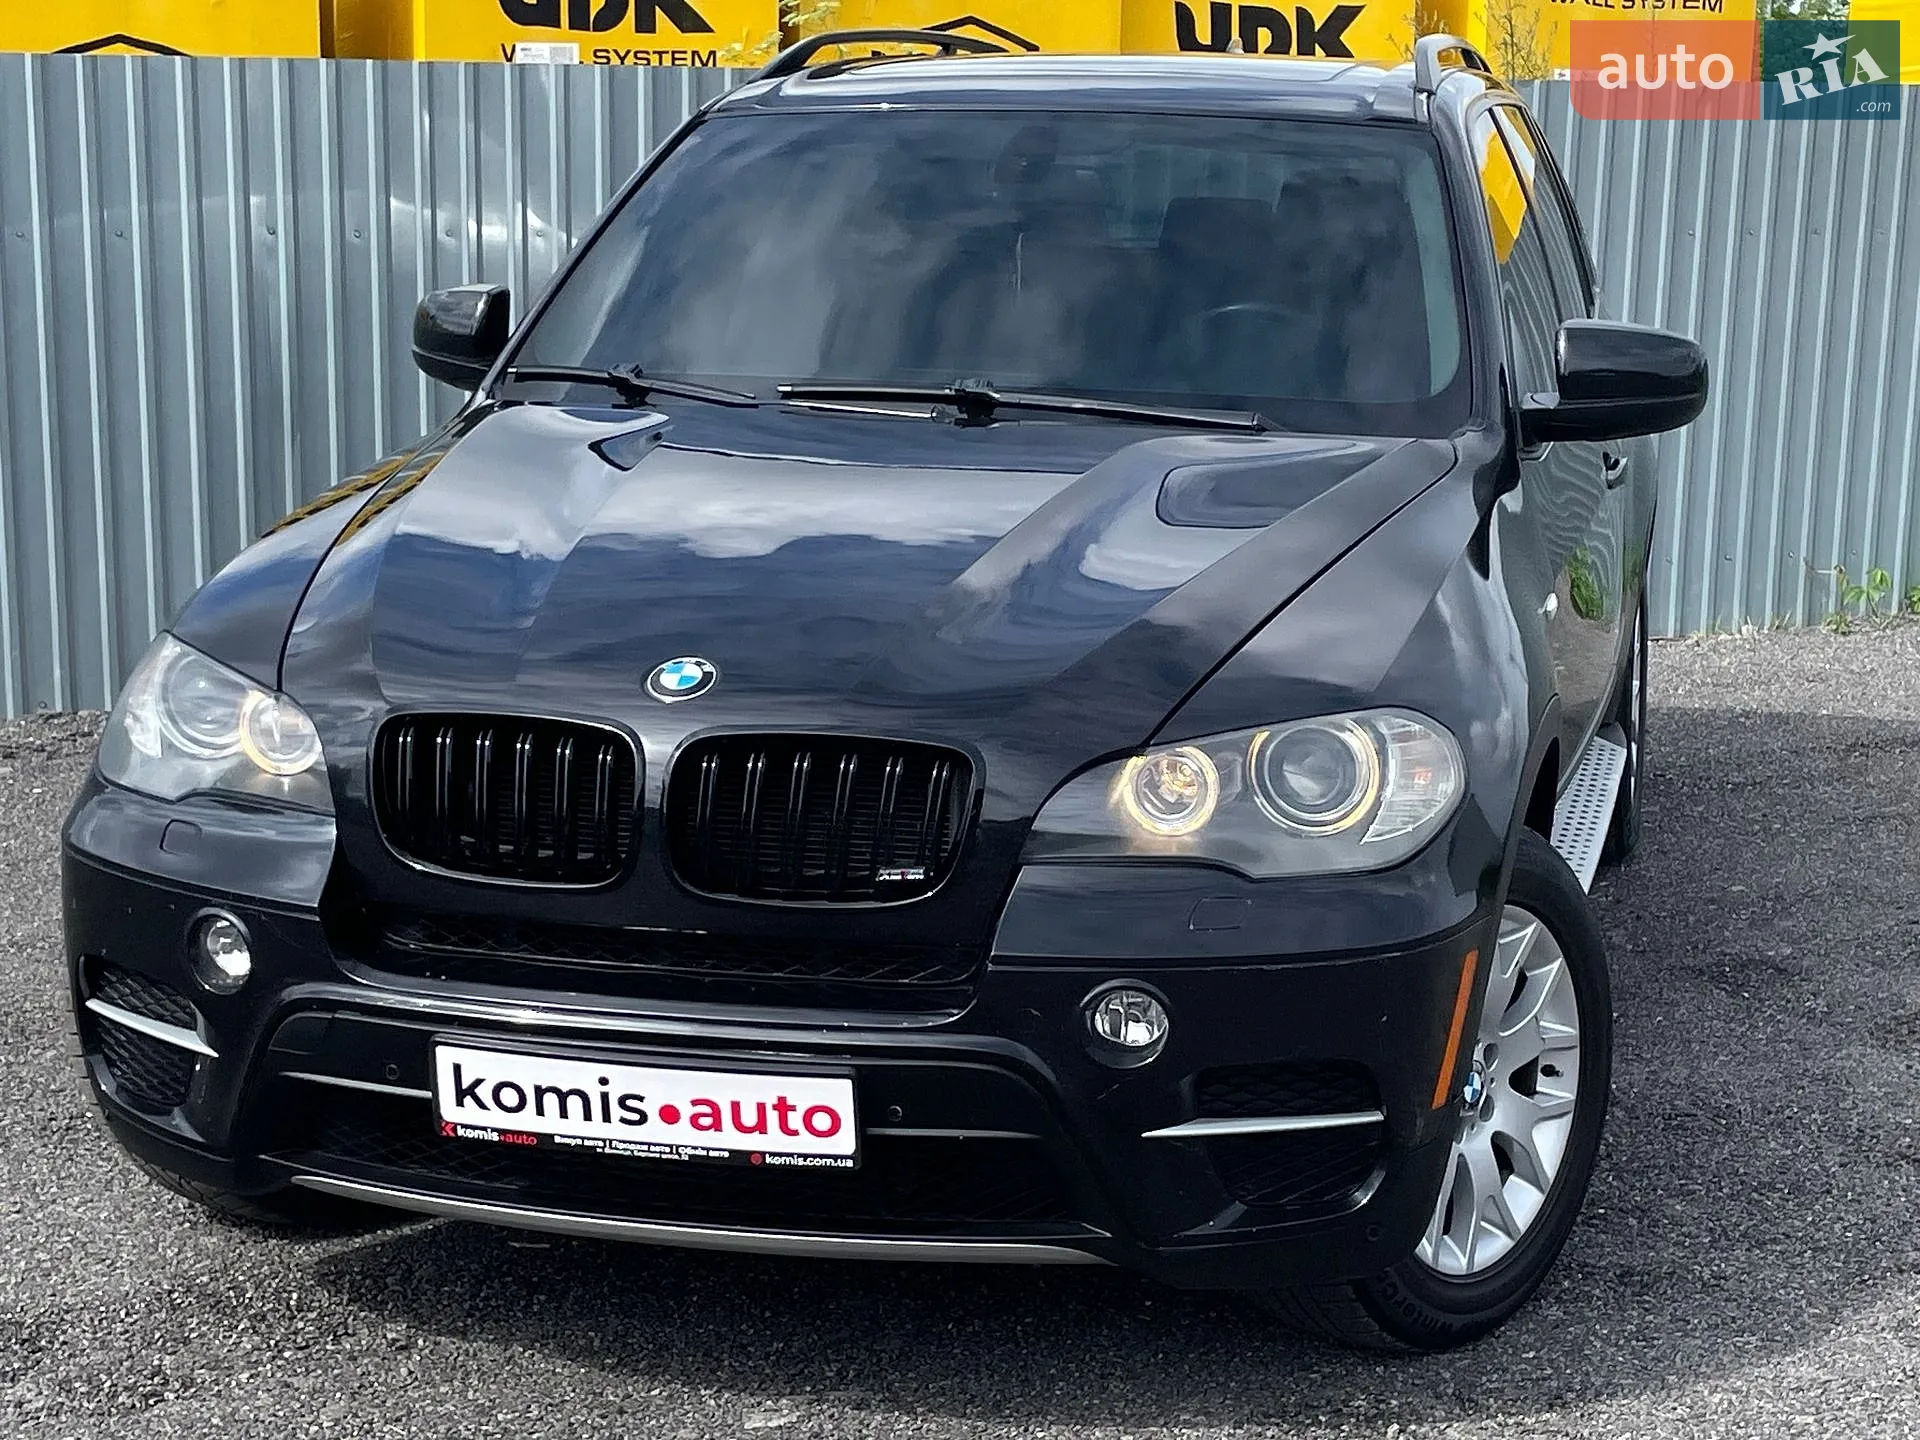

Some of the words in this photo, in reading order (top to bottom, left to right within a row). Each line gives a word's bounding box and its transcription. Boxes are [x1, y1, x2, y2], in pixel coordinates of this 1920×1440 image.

[1174, 1, 1366, 58] UDK
[592, 48, 717, 67] SYSTEM
[765, 1153, 854, 1168] komis.com.ua
